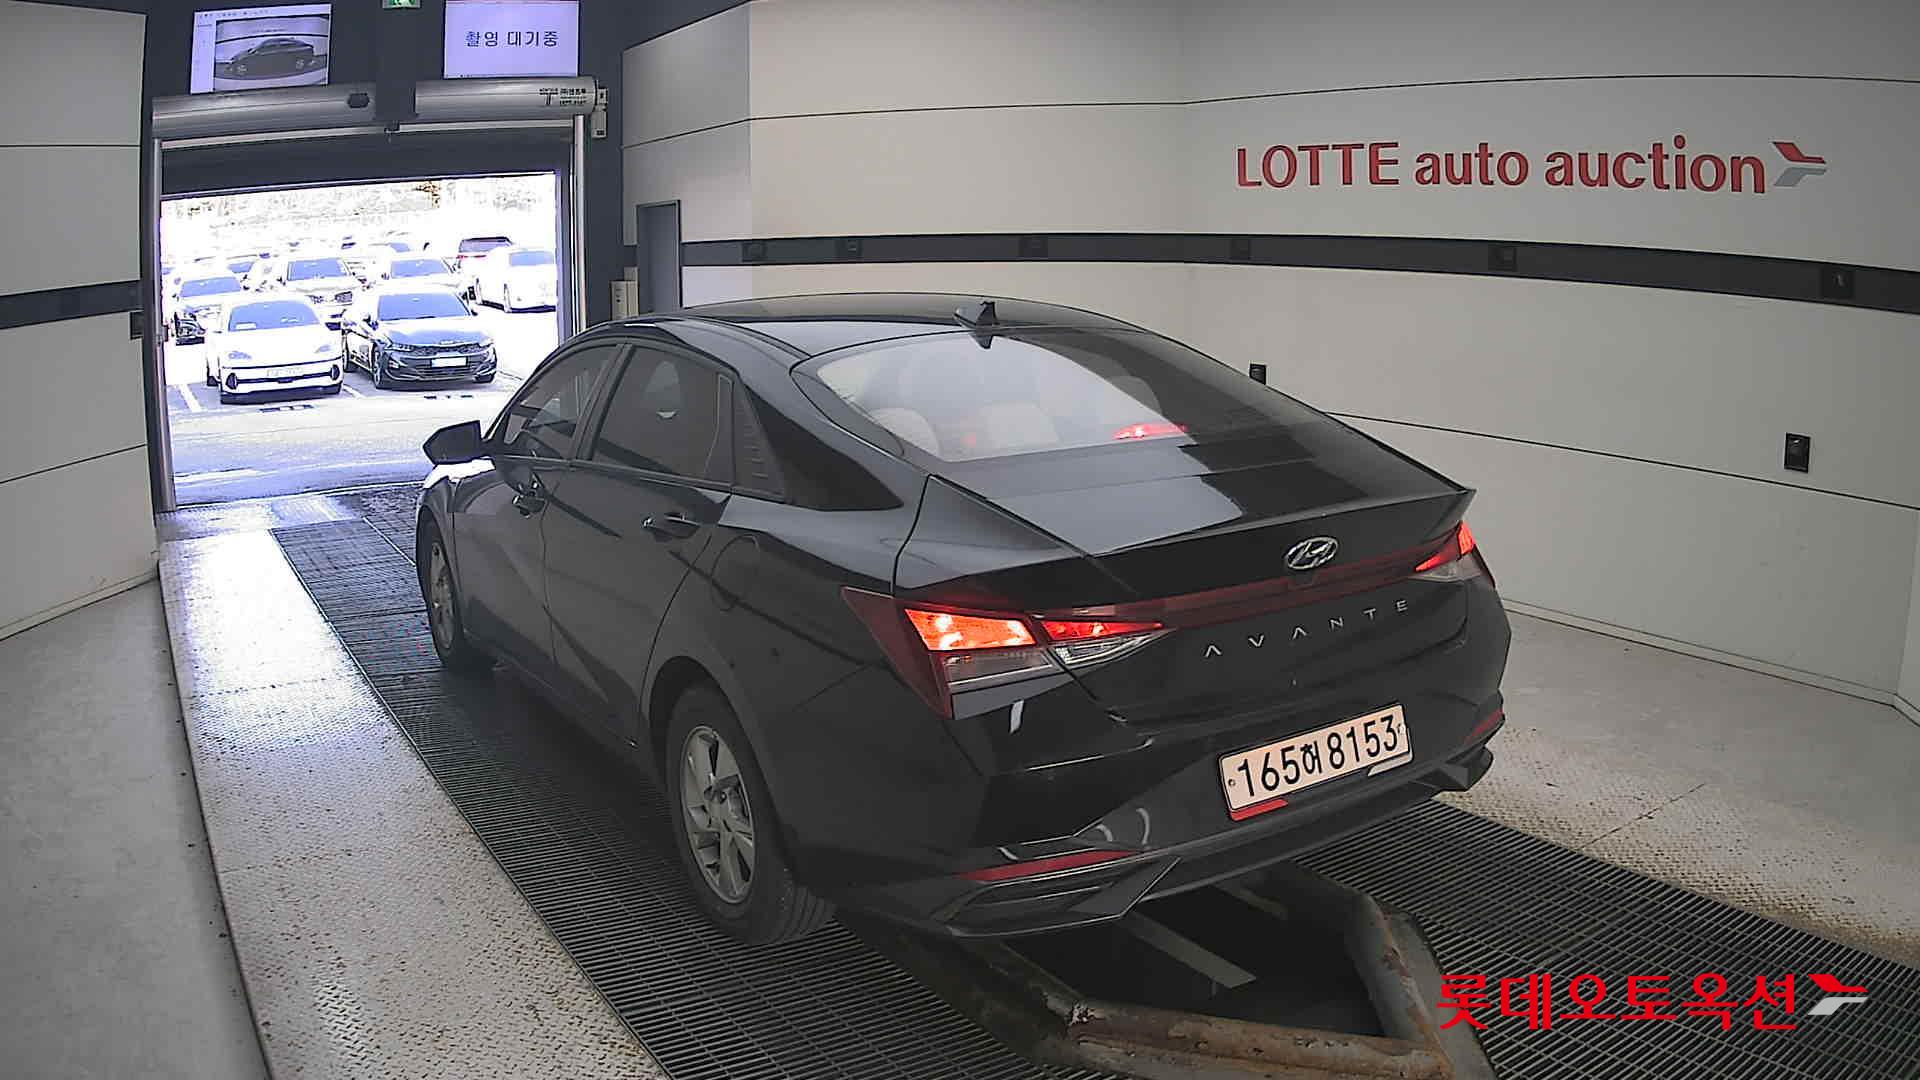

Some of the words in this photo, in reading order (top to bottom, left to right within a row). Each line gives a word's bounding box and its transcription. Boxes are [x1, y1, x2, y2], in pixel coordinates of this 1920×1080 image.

[465, 31, 499, 48] 촬영
[507, 31, 559, 48] 대기중
[1236, 141, 1400, 189] LOTTE
[1414, 142, 1530, 187] auto
[1544, 135, 1767, 194] auction
[1203, 598, 1411, 659] AVANTE
